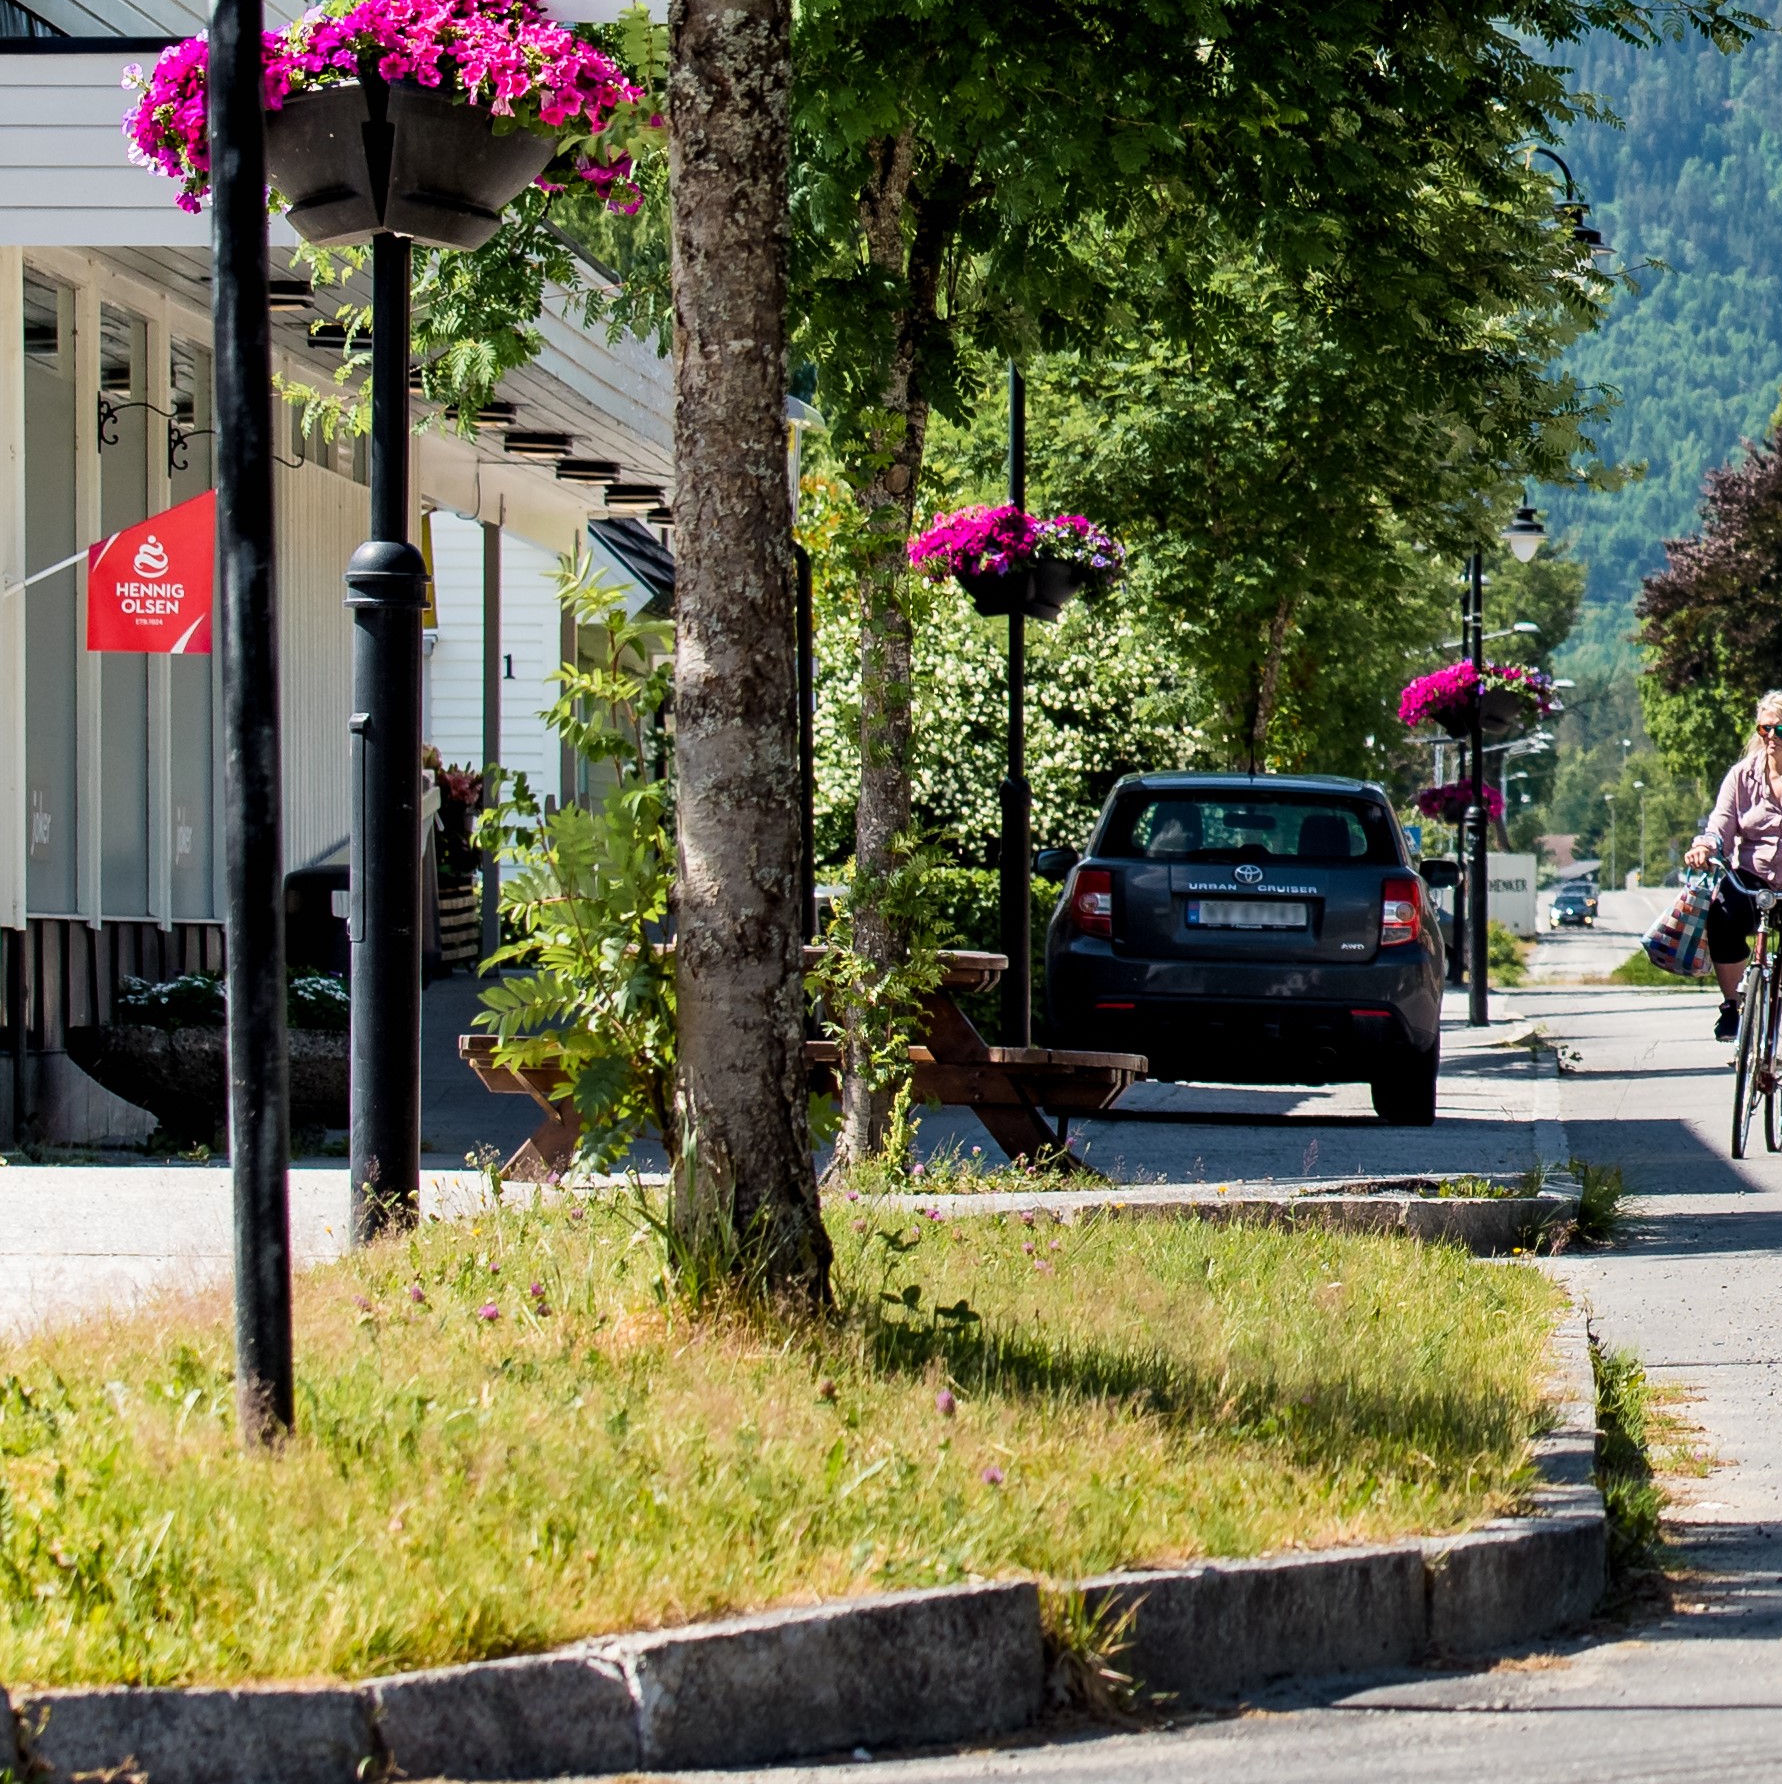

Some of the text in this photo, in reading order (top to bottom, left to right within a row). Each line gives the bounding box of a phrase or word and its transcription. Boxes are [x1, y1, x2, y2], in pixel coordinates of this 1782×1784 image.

[116, 582, 185, 599] HENNIG
[121, 599, 179, 615] OLSEN
[503, 653, 516, 680] 1
[1188, 882, 1318, 894] URBAN CRUISER
